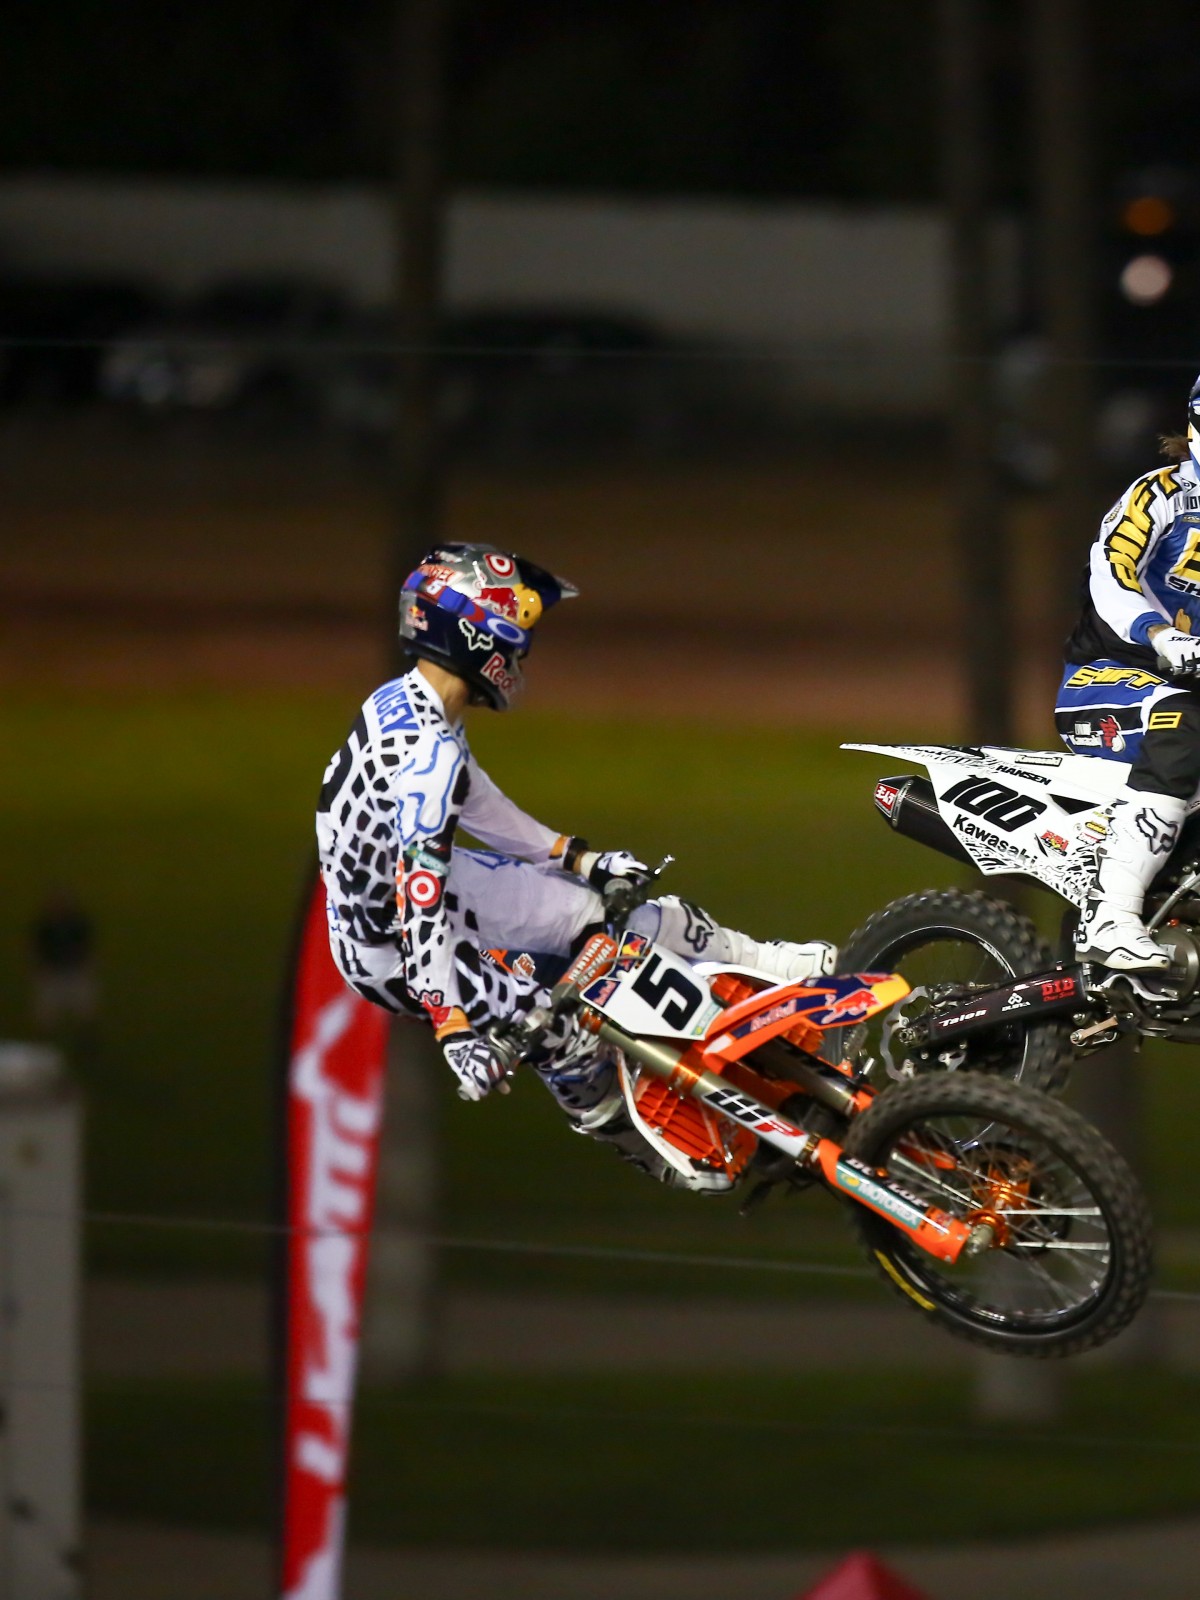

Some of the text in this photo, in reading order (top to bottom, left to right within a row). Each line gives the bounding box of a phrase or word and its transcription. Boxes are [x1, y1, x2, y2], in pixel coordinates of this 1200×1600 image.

[1065, 665, 1168, 690] SHIFT
[372, 677, 420, 734] NGEY
[996, 765, 1051, 786] HANSEN
[939, 774, 1047, 832] 100
[953, 814, 1038, 869] Kawasaki
[631, 953, 703, 1031] 5
[704, 1088, 806, 1138] WP
[845, 1158, 930, 1208] DULOP
[858, 1178, 919, 1227] MOTOREX
